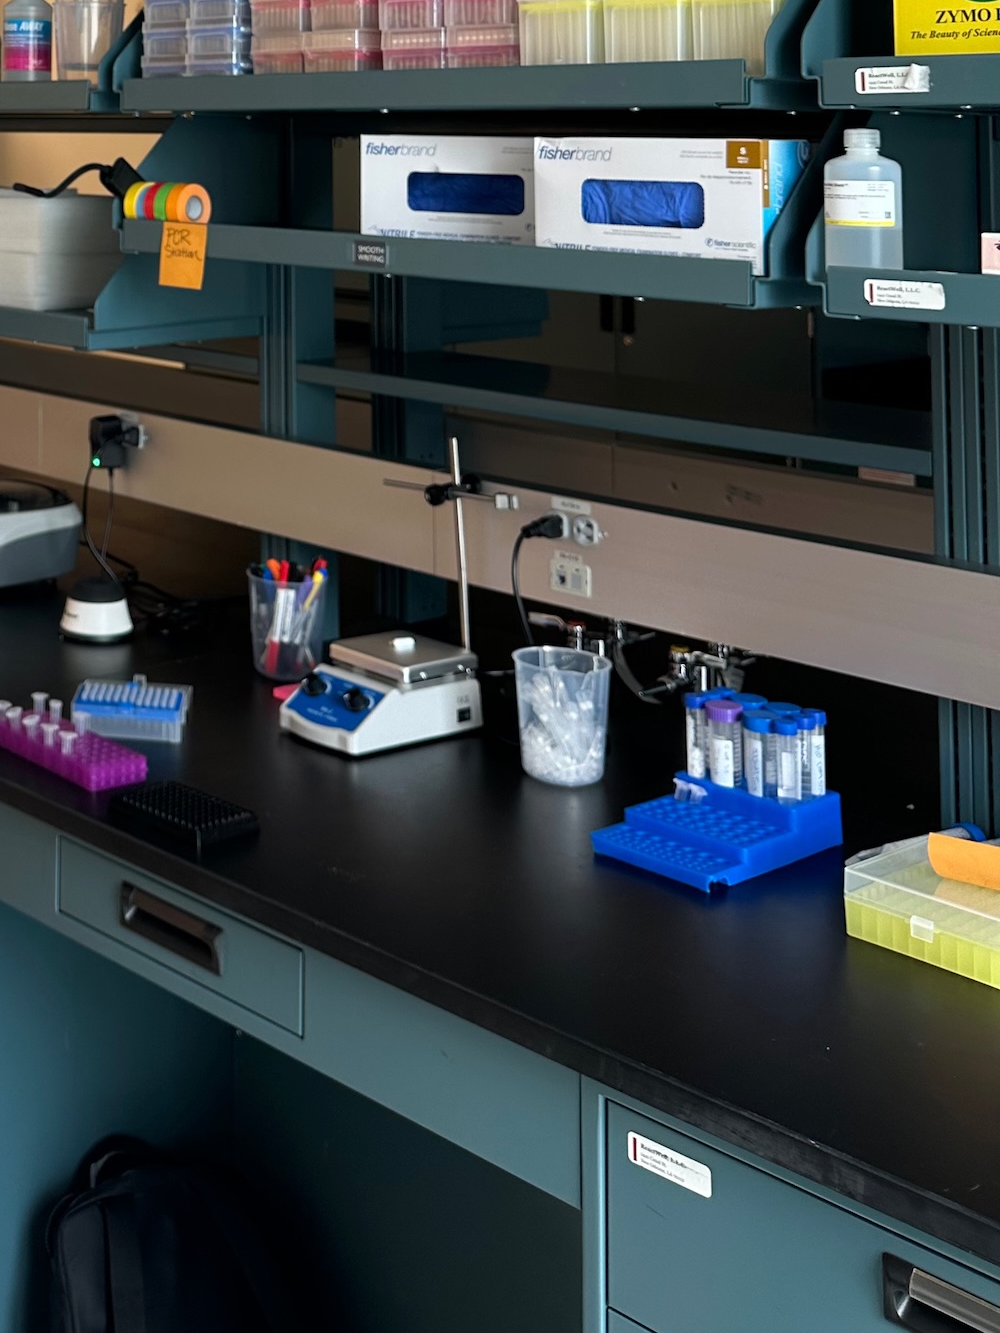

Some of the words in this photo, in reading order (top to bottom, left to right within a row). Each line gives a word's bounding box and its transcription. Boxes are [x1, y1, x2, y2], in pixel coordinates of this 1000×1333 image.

[935, 8, 991, 24] ZYMO
[911, 30, 927, 40] The
[929, 30, 960, 40] Beauty
[962, 29, 973, 40] of
[365, 142, 437, 158] fisherbrand
[538, 145, 613, 162] fisherbrand
[165, 227, 191, 247] PCR
[357, 254, 384, 263] WRITING
